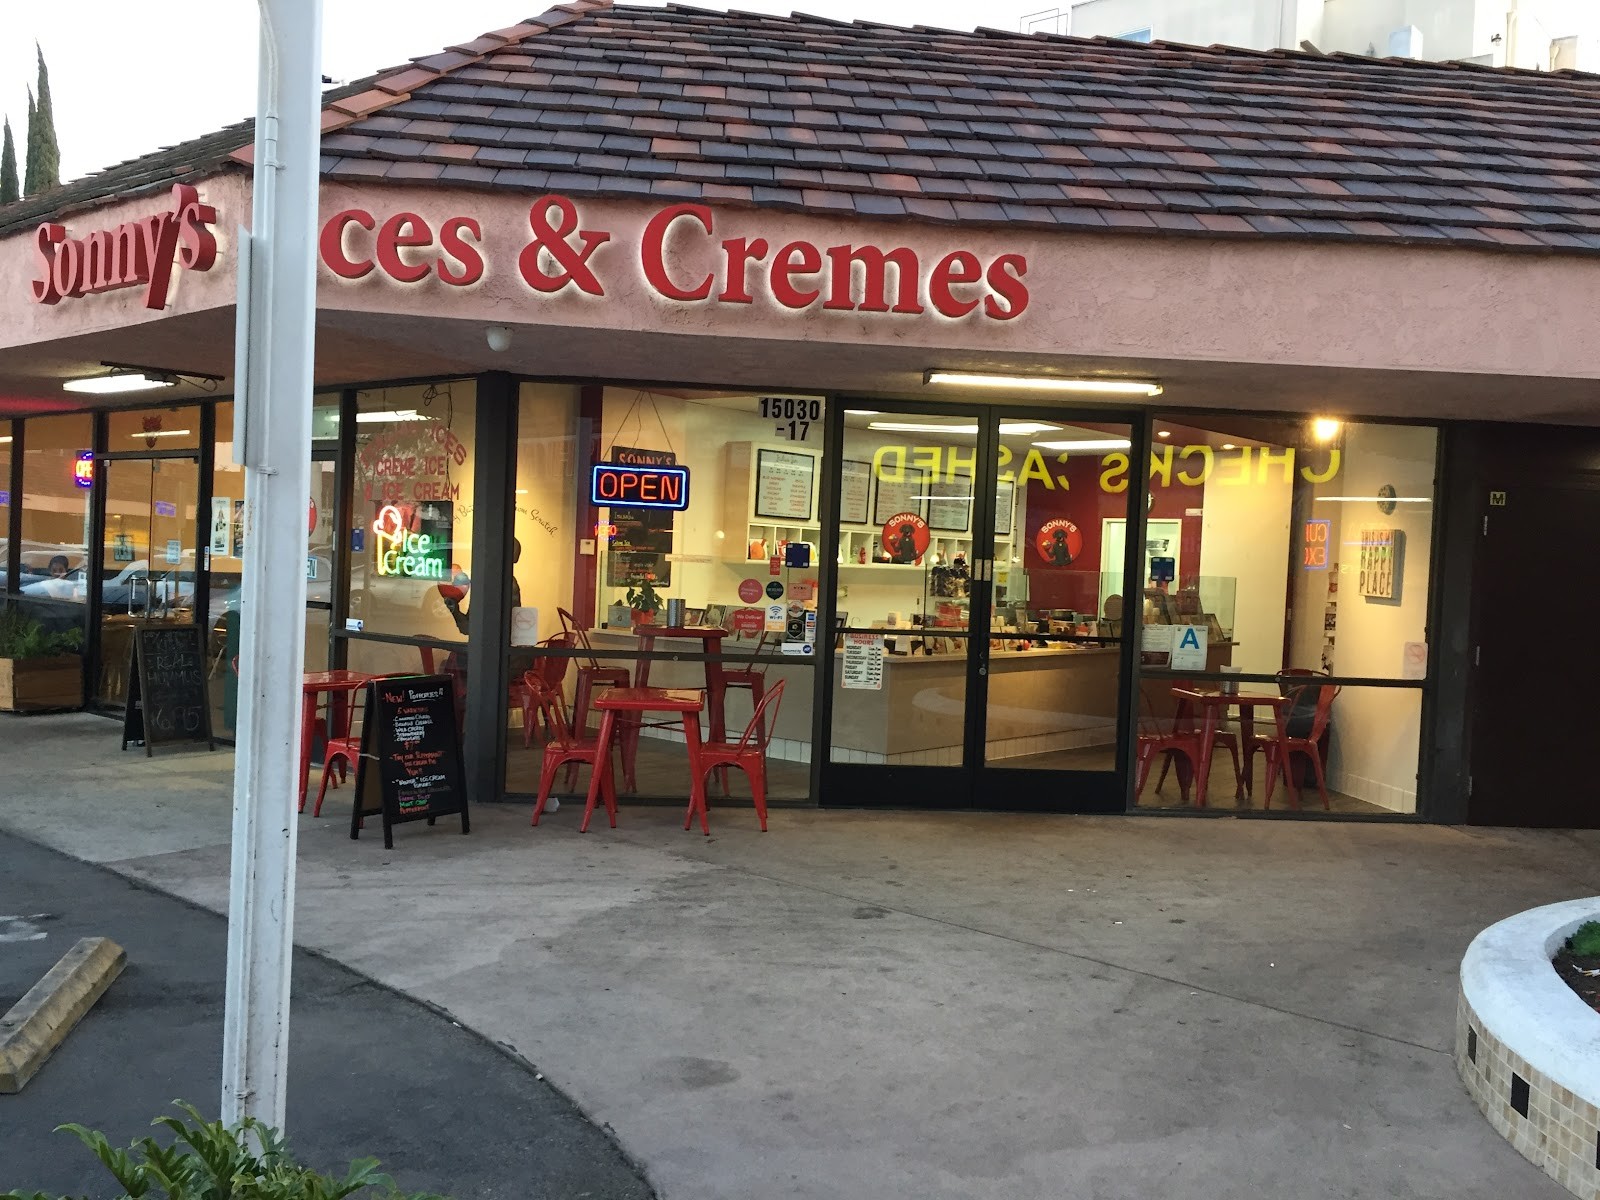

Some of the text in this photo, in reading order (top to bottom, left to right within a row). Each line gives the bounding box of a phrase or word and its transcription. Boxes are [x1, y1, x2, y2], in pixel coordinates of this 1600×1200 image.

[32, 183, 217, 310] Sonny's
[319, 194, 1030, 321] ces & Cremes
[760, 397, 820, 420] 15030
[776, 420, 810, 441] -17
[75, 459, 94, 478] OPE
[424, 456, 446, 476] ICE
[413, 481, 460, 501] CREAM
[600, 472, 679, 501] OPEN
[888, 514, 925, 529] SONNY'S
[1041, 519, 1078, 534] SONNY'S
[402, 526, 431, 554] Ice
[384, 550, 443, 578] Cream
[1359, 569, 1392, 596] PLACE
[1179, 627, 1200, 650] A
